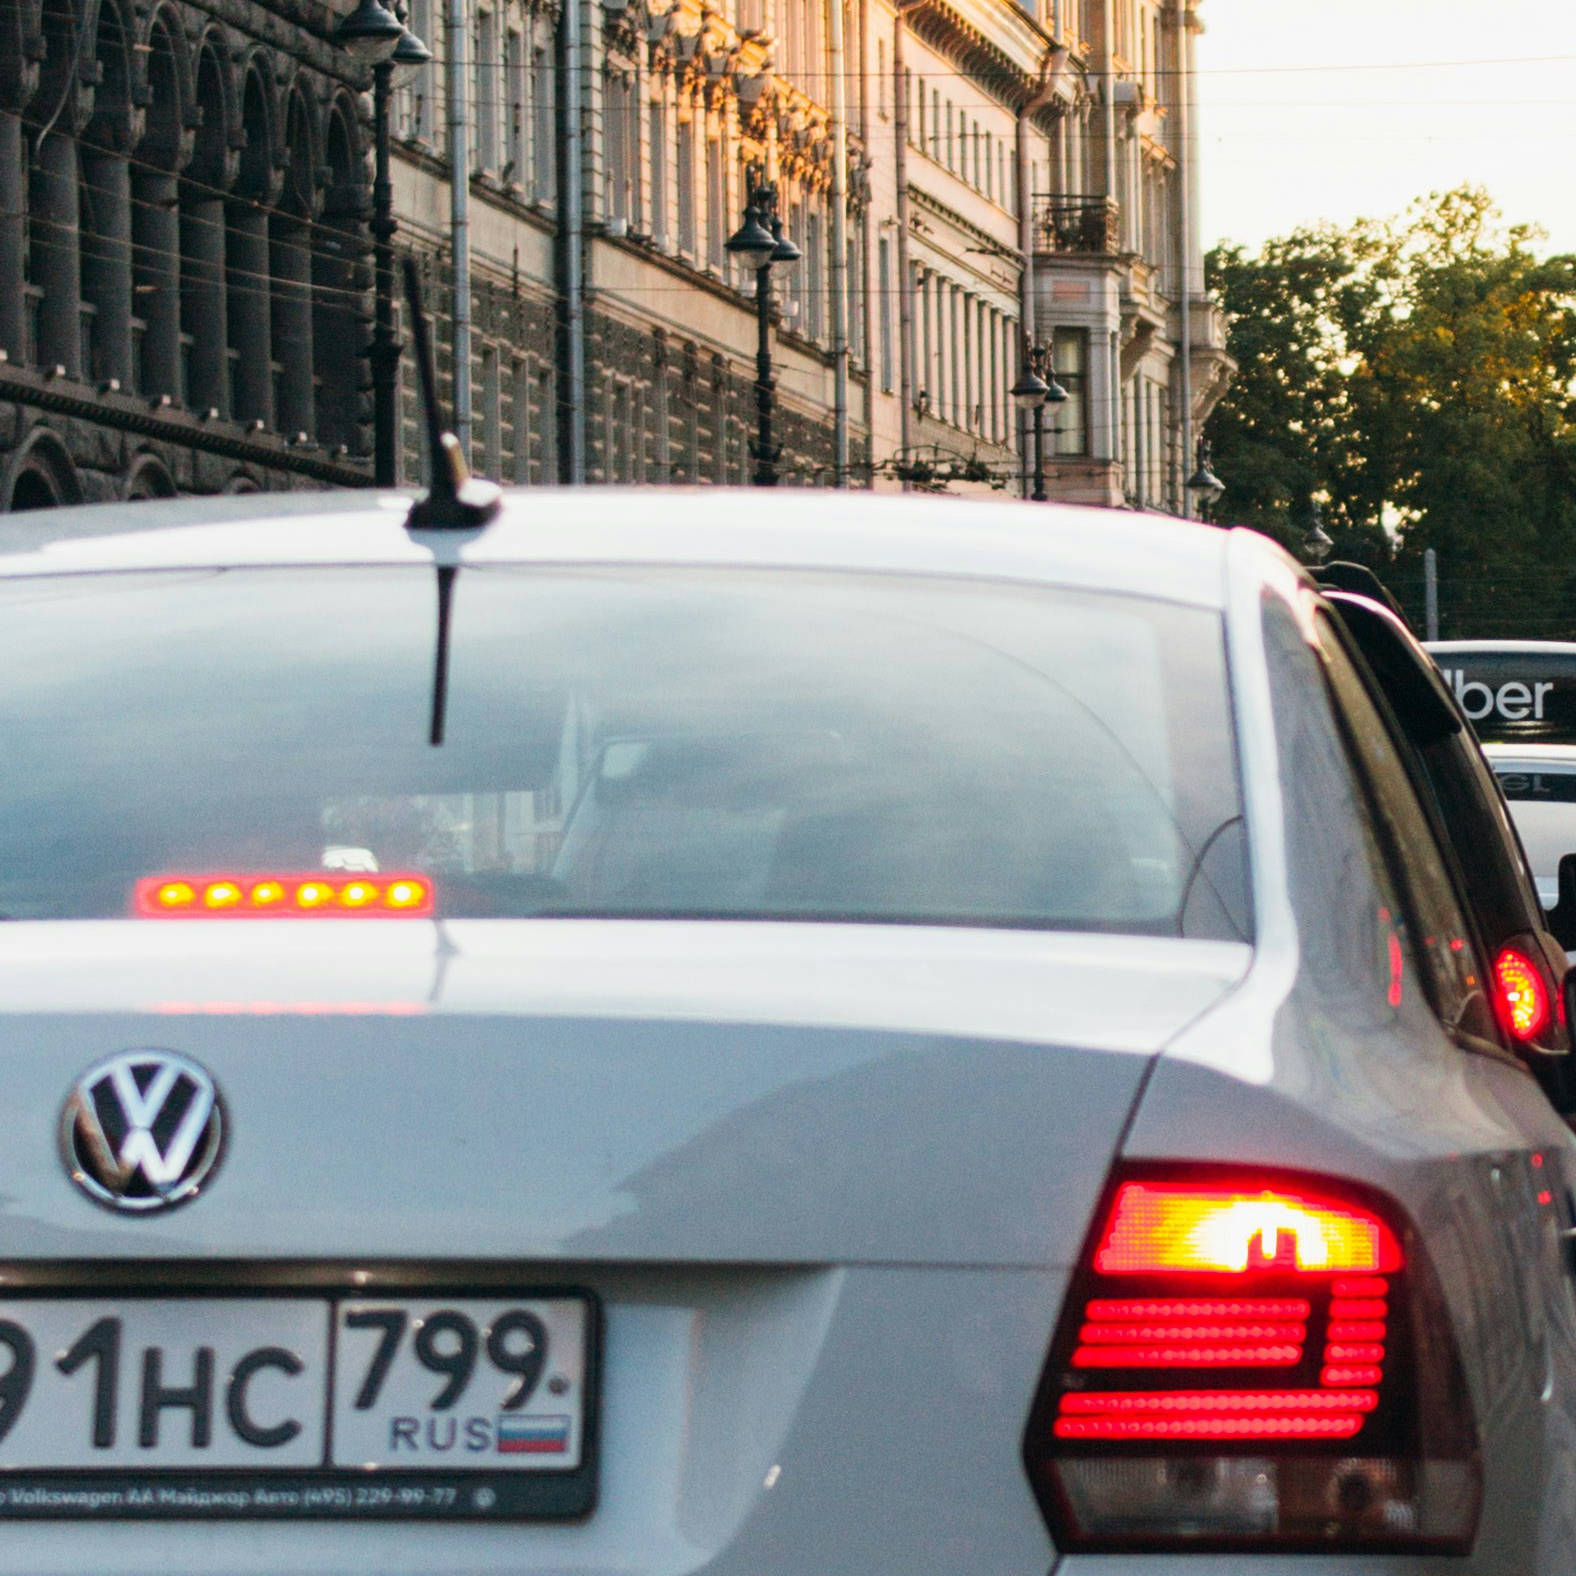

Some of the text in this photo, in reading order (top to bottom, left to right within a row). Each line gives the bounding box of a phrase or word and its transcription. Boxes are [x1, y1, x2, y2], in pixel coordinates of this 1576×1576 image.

[1444, 668, 1554, 720] ber
[344, 1308, 550, 1411] 799
[389, 1416, 495, 1451] RUS
[9, 1488, 123, 1508] Volkswagen
